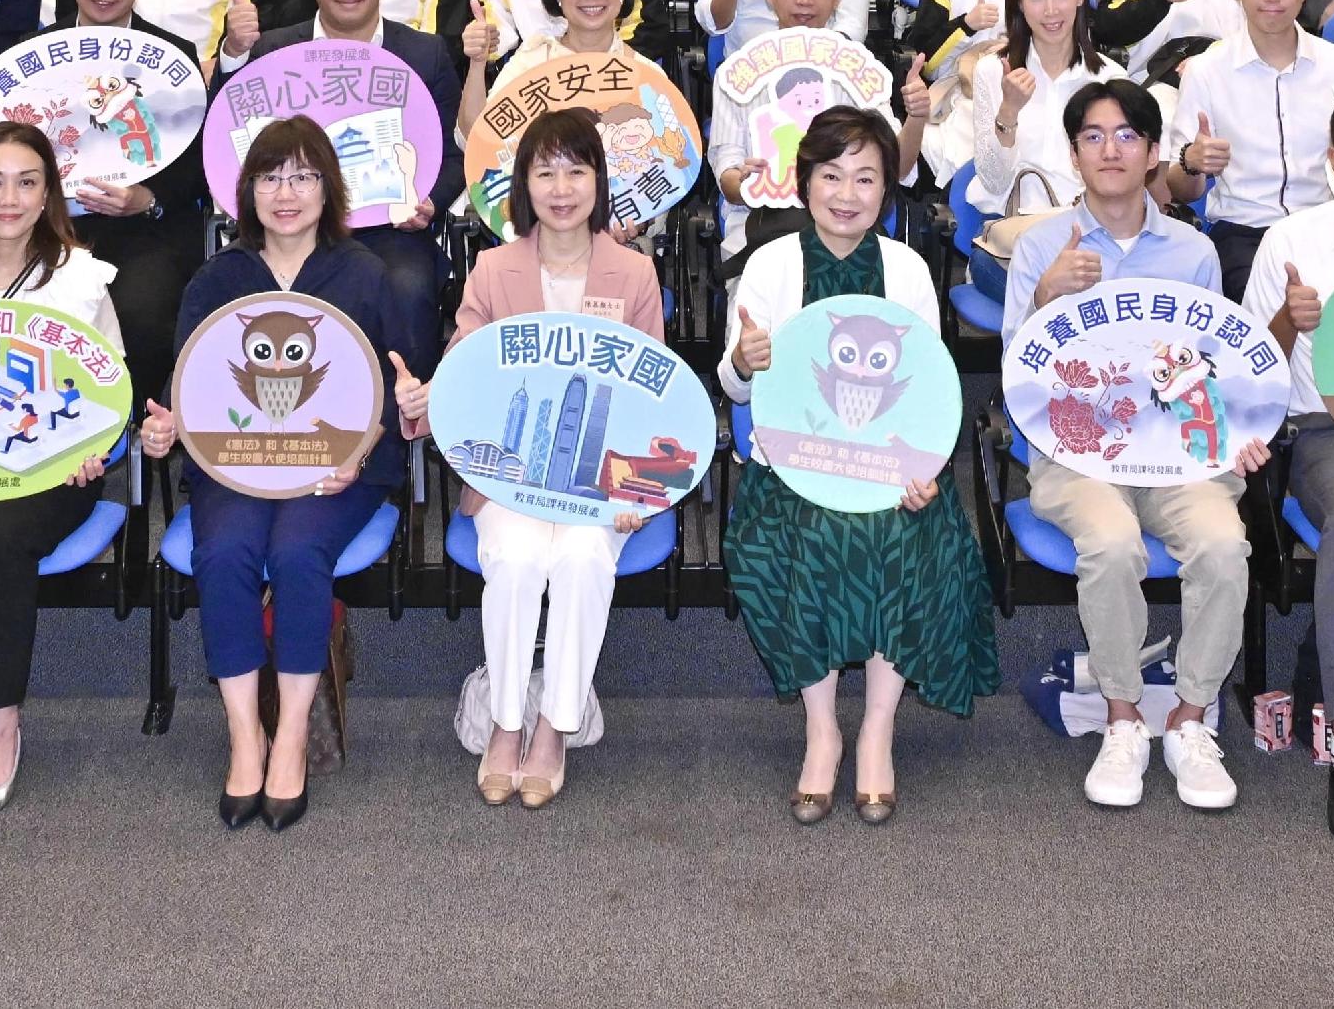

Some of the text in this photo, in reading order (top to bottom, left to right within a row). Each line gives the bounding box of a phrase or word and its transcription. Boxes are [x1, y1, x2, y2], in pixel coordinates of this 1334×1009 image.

[304, 48, 371, 63] 課程發展處
[727, 34, 885, 101] 維護國家安全
[226, 64, 410, 127] 關心家國
[483, 57, 634, 139] 國家安全
[26, 316, 121, 384] 《基本法》
[500, 323, 677, 398] 關心家國
[1018, 292, 1279, 376] 培養國民身份認同
[266, 440, 277, 451] 和
[282, 439, 330, 452] 《基本法》
[514, 491, 600, 518] 教育局課程發展處
